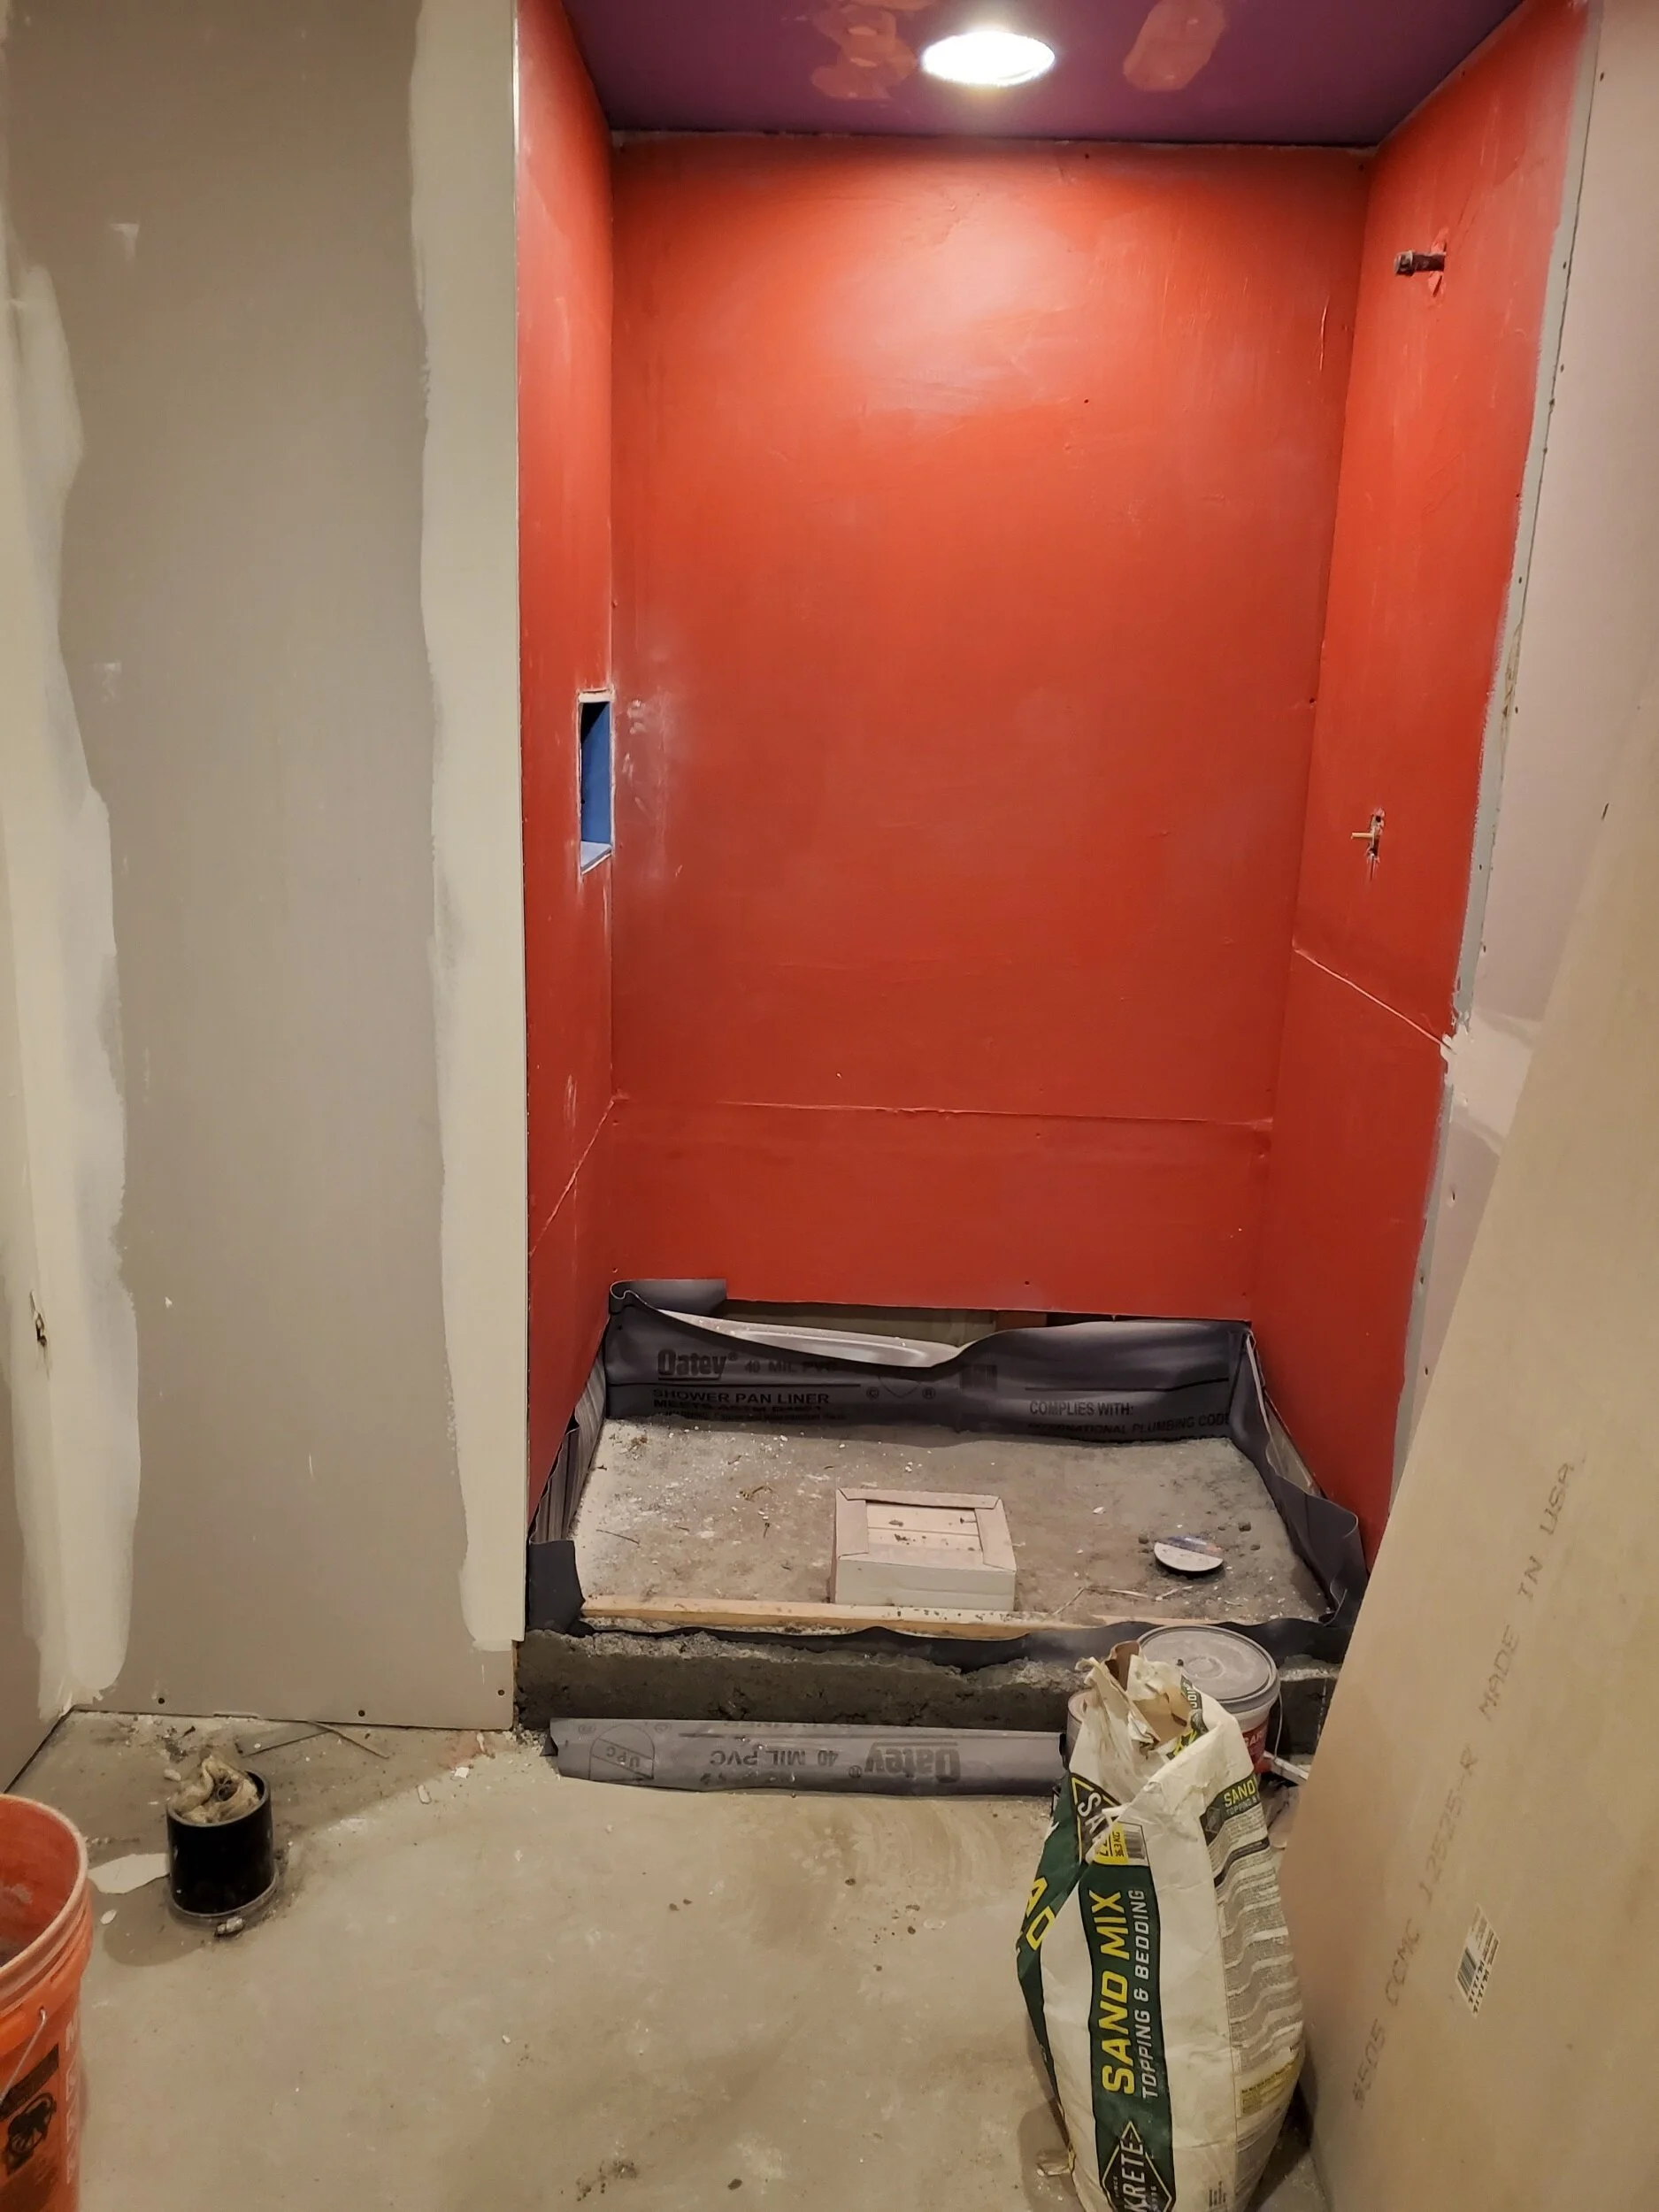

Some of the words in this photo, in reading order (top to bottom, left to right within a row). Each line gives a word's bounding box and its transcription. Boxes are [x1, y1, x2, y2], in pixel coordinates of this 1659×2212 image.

[657, 1348, 727, 1380] Oatey
[653, 1388, 730, 1403] SHOWER
[735, 1393, 772, 1404] PAN
[777, 1393, 830, 1404] LINER
[1029, 1400, 1095, 1417] COMPLIES
[1098, 1401, 1134, 1417] WITH:
[1132, 1415, 1195, 1434] PLUMBING
[1479, 1624, 1519, 1723] MADE
[1517, 1555, 1544, 1601] IN
[605, 1746, 641, 1768] UPC
[710, 1750, 758, 1766] PVC
[765, 1749, 806, 1766] MIL
[817, 1749, 839, 1767] 40
[864, 1740, 962, 1784] Oatey
[1223, 1778, 1256, 1809] SAND
[1088, 1889, 1131, 1961] MIX
[1127, 1889, 1150, 1980] BEDDING
[1133, 1987, 1149, 2002] &
[1098, 1970, 1135, 2095] SAND
[1134, 2008, 1159, 2101] TOPPING
